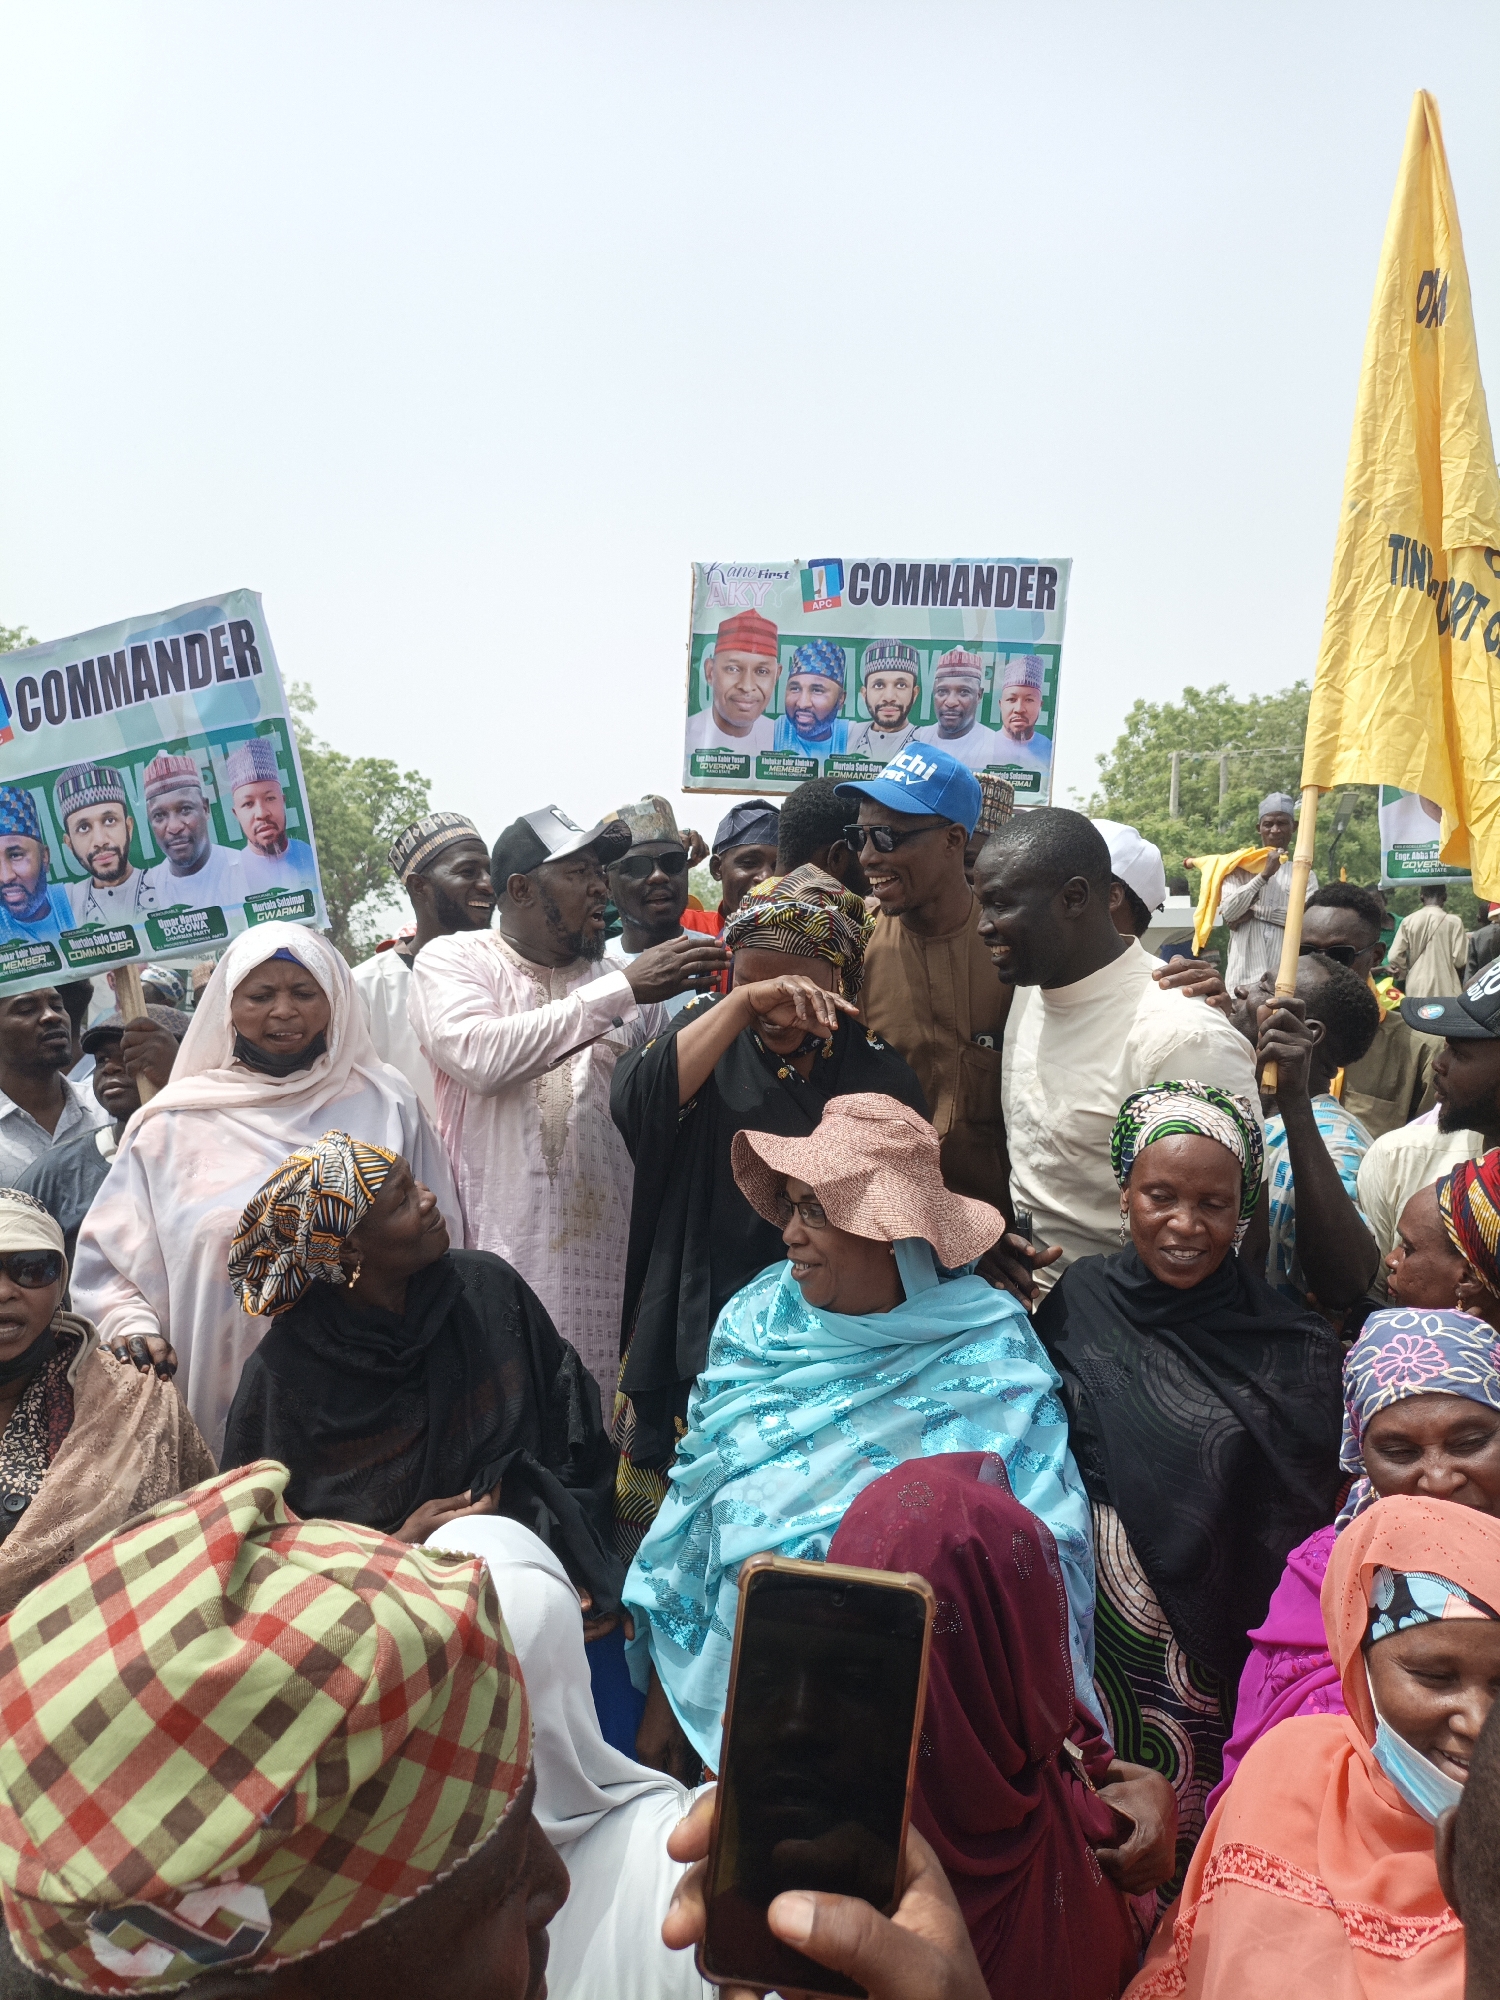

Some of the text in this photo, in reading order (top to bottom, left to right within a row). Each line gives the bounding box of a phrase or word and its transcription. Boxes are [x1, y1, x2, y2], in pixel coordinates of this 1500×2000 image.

[703, 561, 790, 585] Kano First
[706, 581, 772, 607] AKY
[849, 562, 1058, 611] COMMANDER
[812, 599, 832, 610] APC
[16, 619, 262, 732] COMMANDER
[769, 765, 807, 773] MEMBER
[827, 771, 879, 780] COMMANDE
[1395, 852, 1410, 861] Engr.
[1411, 851, 1428, 860] Abba
[252, 894, 305, 913] Murtala Sulaiman
[158, 911, 208, 929] Umar Haruna
[257, 904, 304, 921] GWARMAI
[164, 920, 208, 936] DOGOWA
[165, 929, 211, 942] CHAIRMAN PARTY
[68, 937, 94, 950] Murtala
[108, 930, 127, 942] Garo
[68, 940, 134, 961] COMMANDER
[3, 954, 47, 970] MEMBER
